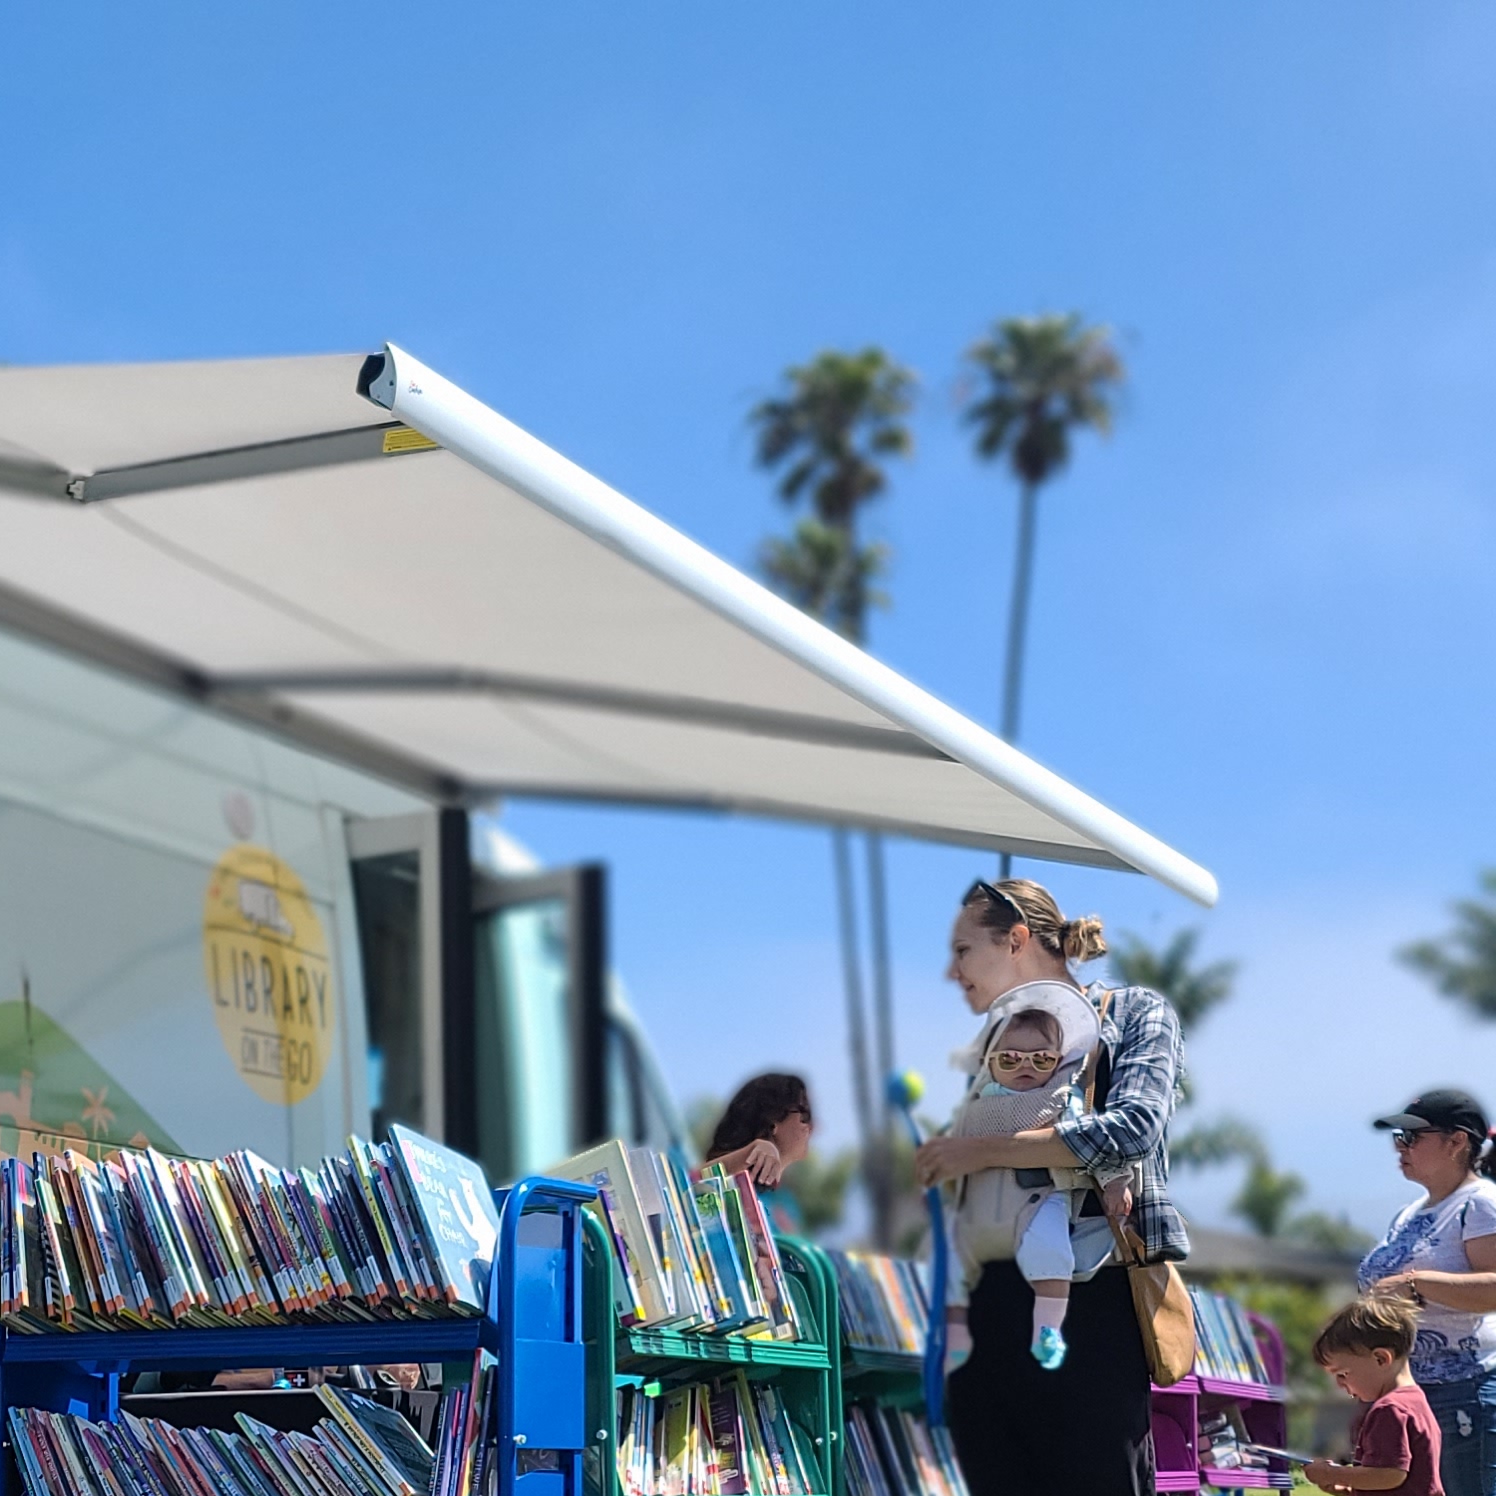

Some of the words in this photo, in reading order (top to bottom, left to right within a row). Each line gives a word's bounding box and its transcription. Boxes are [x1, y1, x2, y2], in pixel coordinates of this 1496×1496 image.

[211, 943, 327, 1029] LIBRARY
[241, 1035, 259, 1066] ON
[286, 1038, 313, 1086] GO
